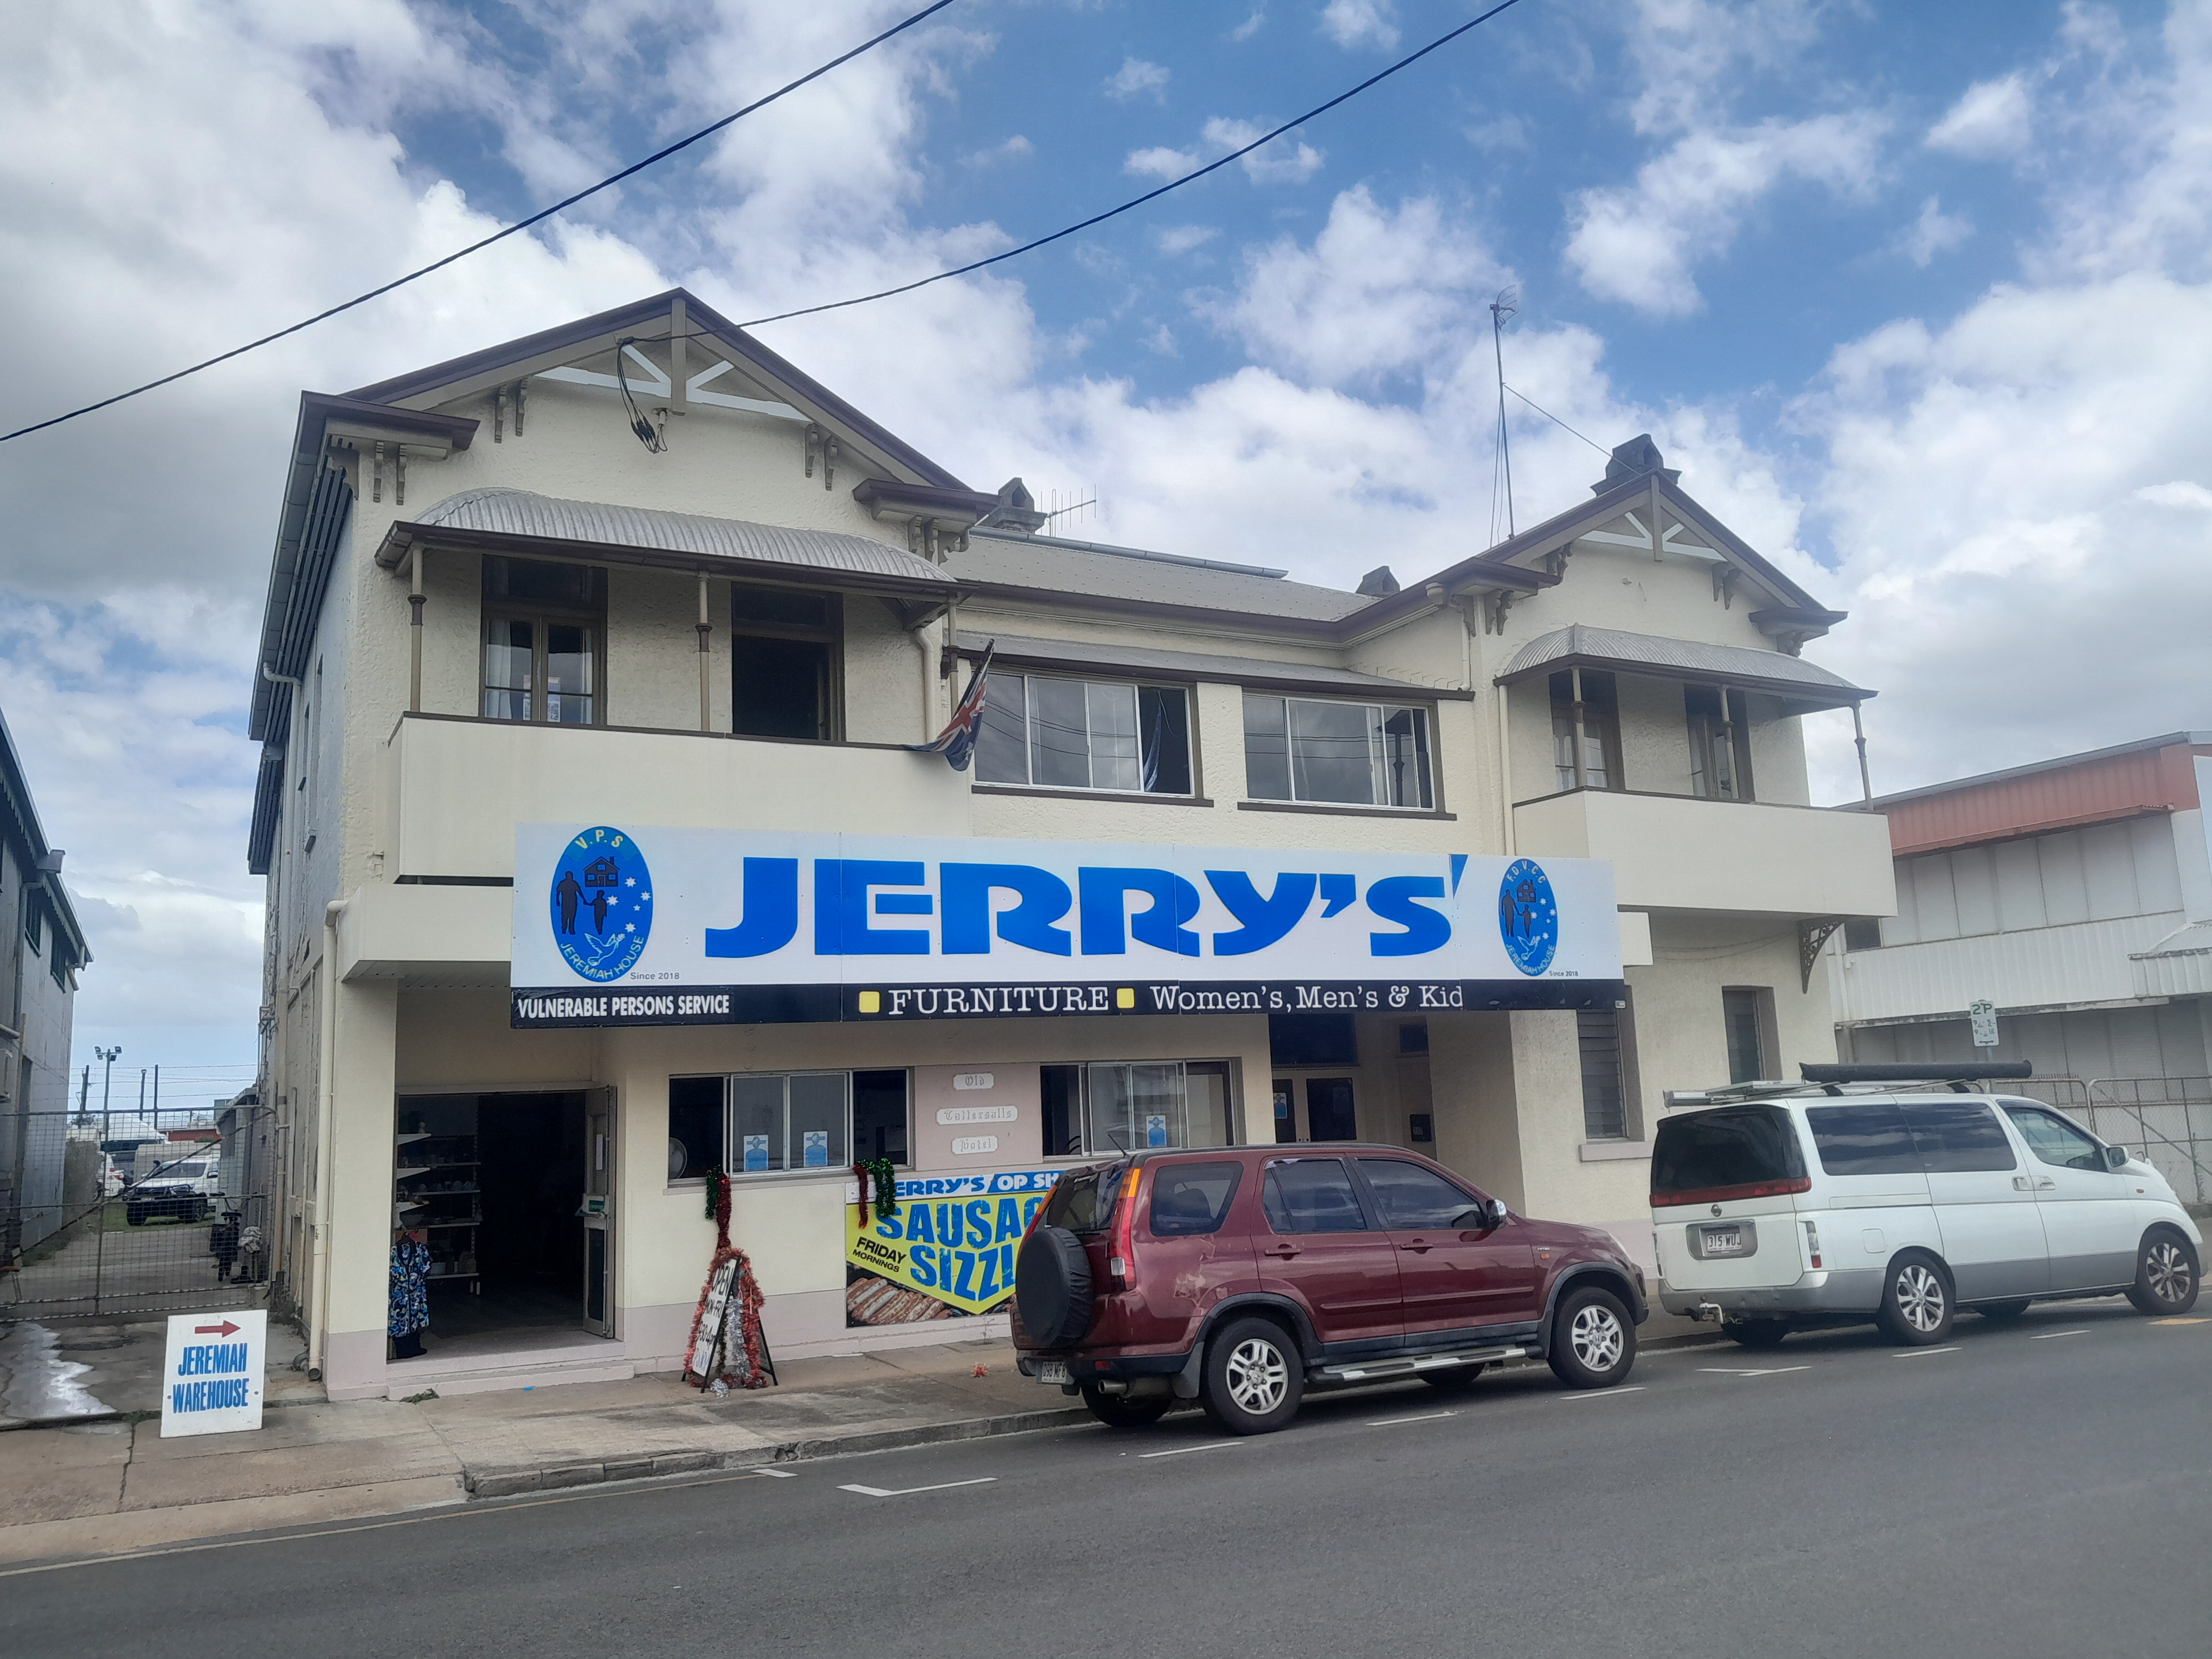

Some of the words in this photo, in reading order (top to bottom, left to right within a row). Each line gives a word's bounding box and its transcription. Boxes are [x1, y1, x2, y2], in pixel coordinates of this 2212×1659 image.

[705, 857, 1451, 959] JERRY'S
[561, 943, 614, 979] JEREMIAH
[614, 935, 644, 975] HOUSE
[1506, 943, 1538, 974] JEREMIAH
[1538, 943, 1555, 974] HOUSE
[630, 972, 655, 980] Since
[658, 972, 680, 980] 2018
[518, 997, 608, 1018] VULNERABLE
[612, 996, 674, 1015] PERSONS
[678, 995, 730, 1014] SERVICE
[888, 987, 1109, 1015] FURNITURE
[1388, 985, 1409, 1007] &
[1419, 985, 1463, 1007] Kid
[1971, 1003, 1993, 1014] 2P
[965, 1075, 985, 1086] Old
[895, 1176, 986, 1197] ERRY'S
[997, 1174, 1029, 1190] OP
[1033, 1173, 1058, 1189] SH
[876, 1196, 1046, 1250] SAUSA
[852, 1249, 900, 1274] MORNINGS
[856, 1236, 907, 1264] FRIDAY
[711, 1264, 734, 1297] OPEN
[178, 1342, 248, 1377] JEREMIAH
[172, 1378, 249, 1414] WAREHOUSE
